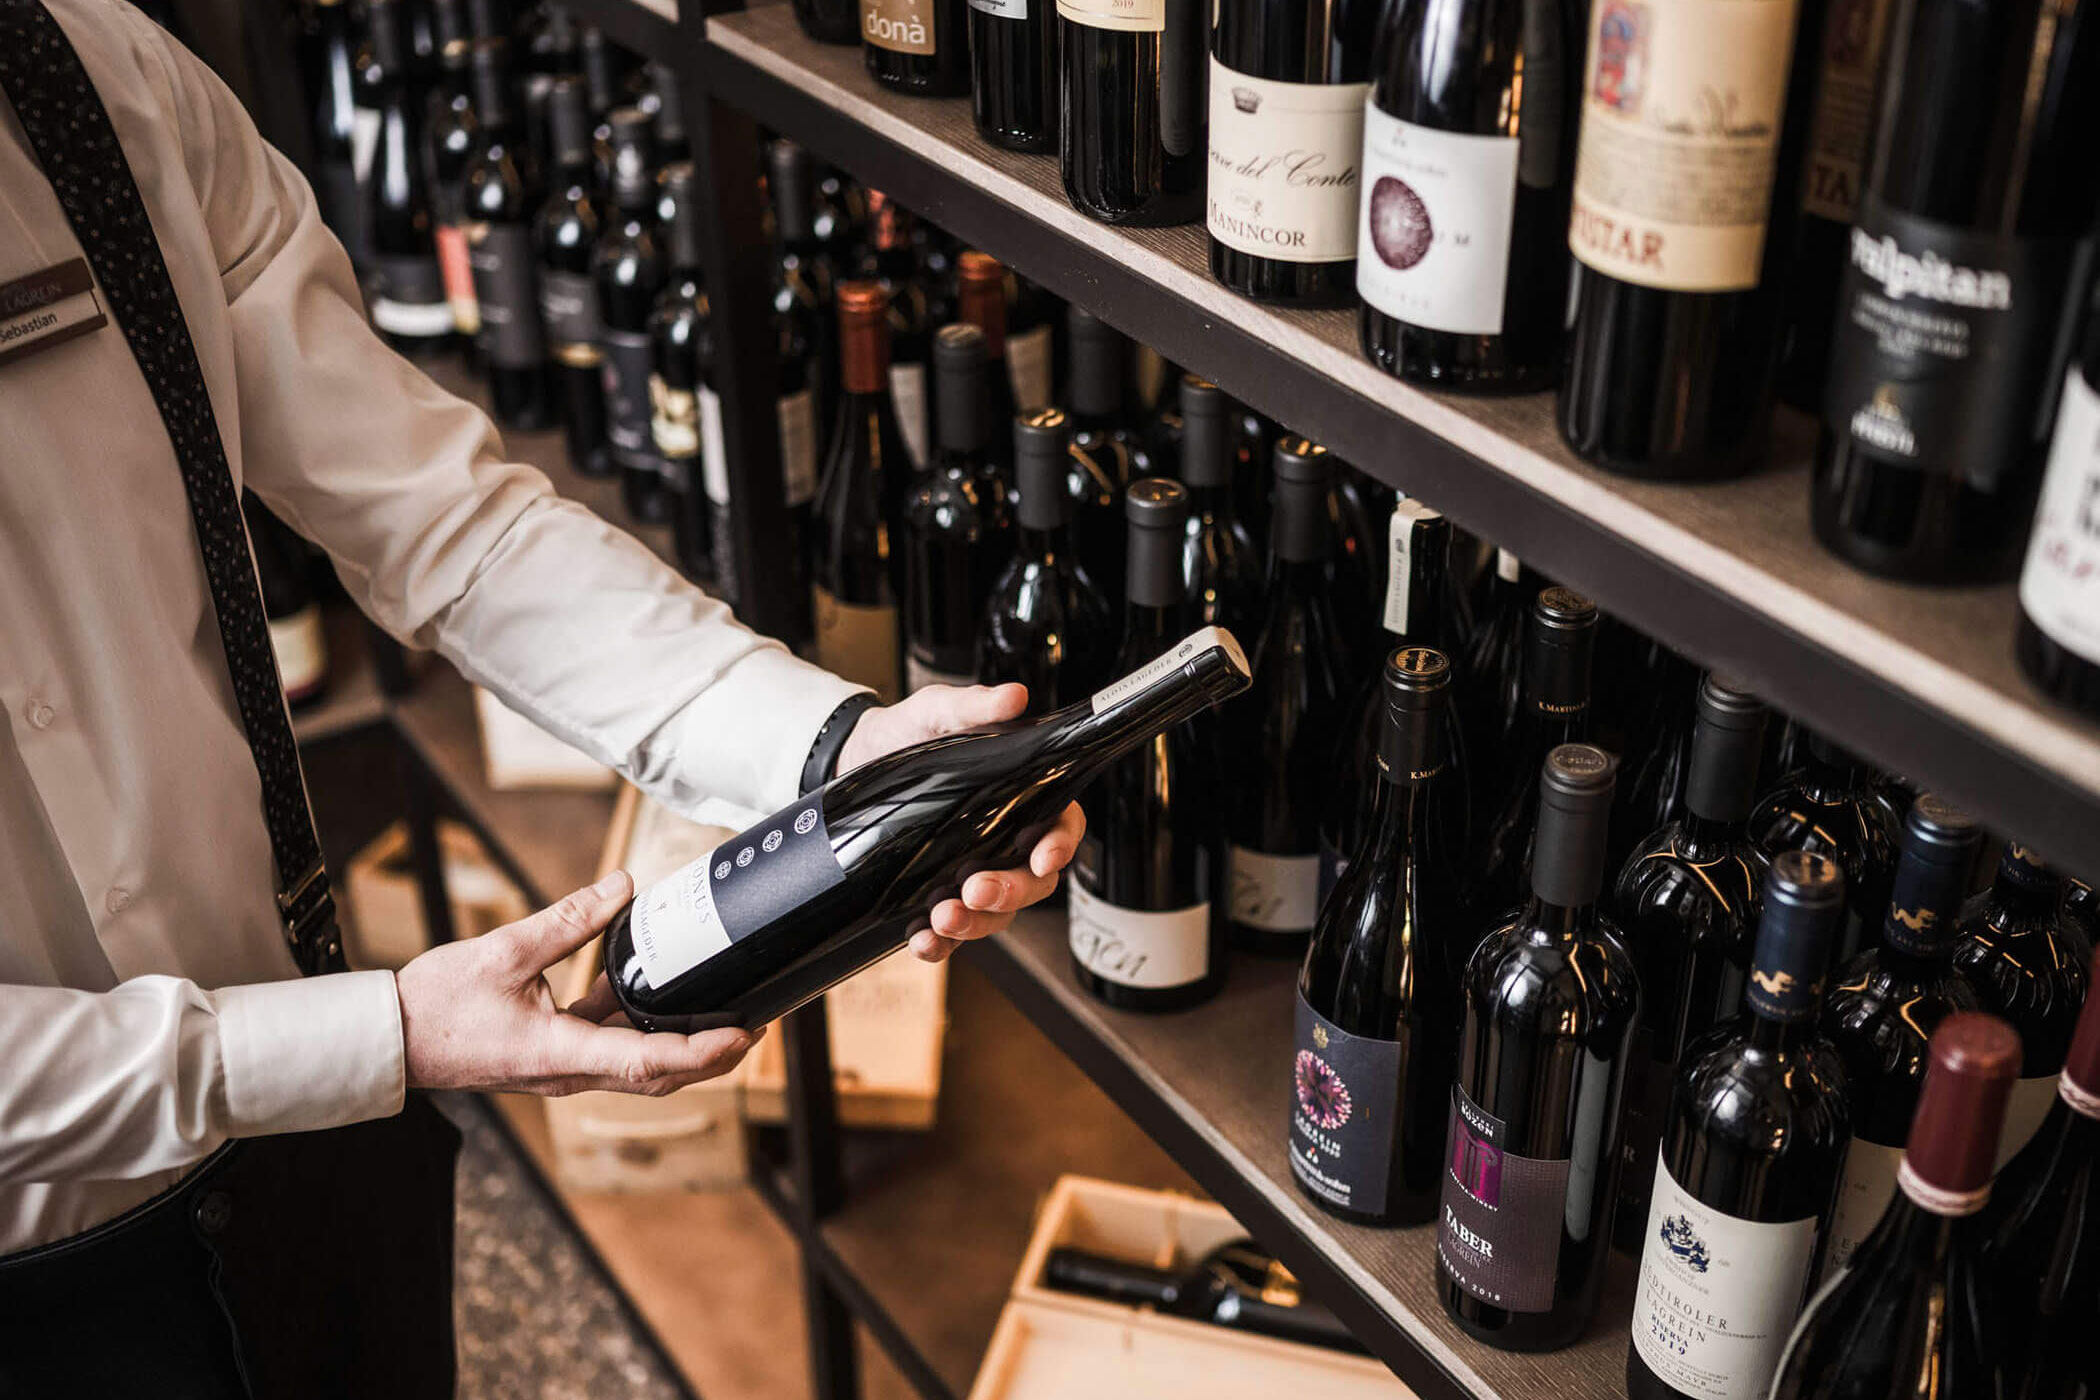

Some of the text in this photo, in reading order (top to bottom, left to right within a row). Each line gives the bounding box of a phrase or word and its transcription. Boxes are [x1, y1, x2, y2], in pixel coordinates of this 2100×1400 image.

[866, 9, 926, 45] donà
[1284, 150, 1356, 188] Conte
[1209, 198, 1309, 248] MANINCOR
[1446, 1204, 1494, 1259] TABER
[1646, 1290, 1707, 1344] LAGREIN
[1651, 1326, 1687, 1357] 2019
